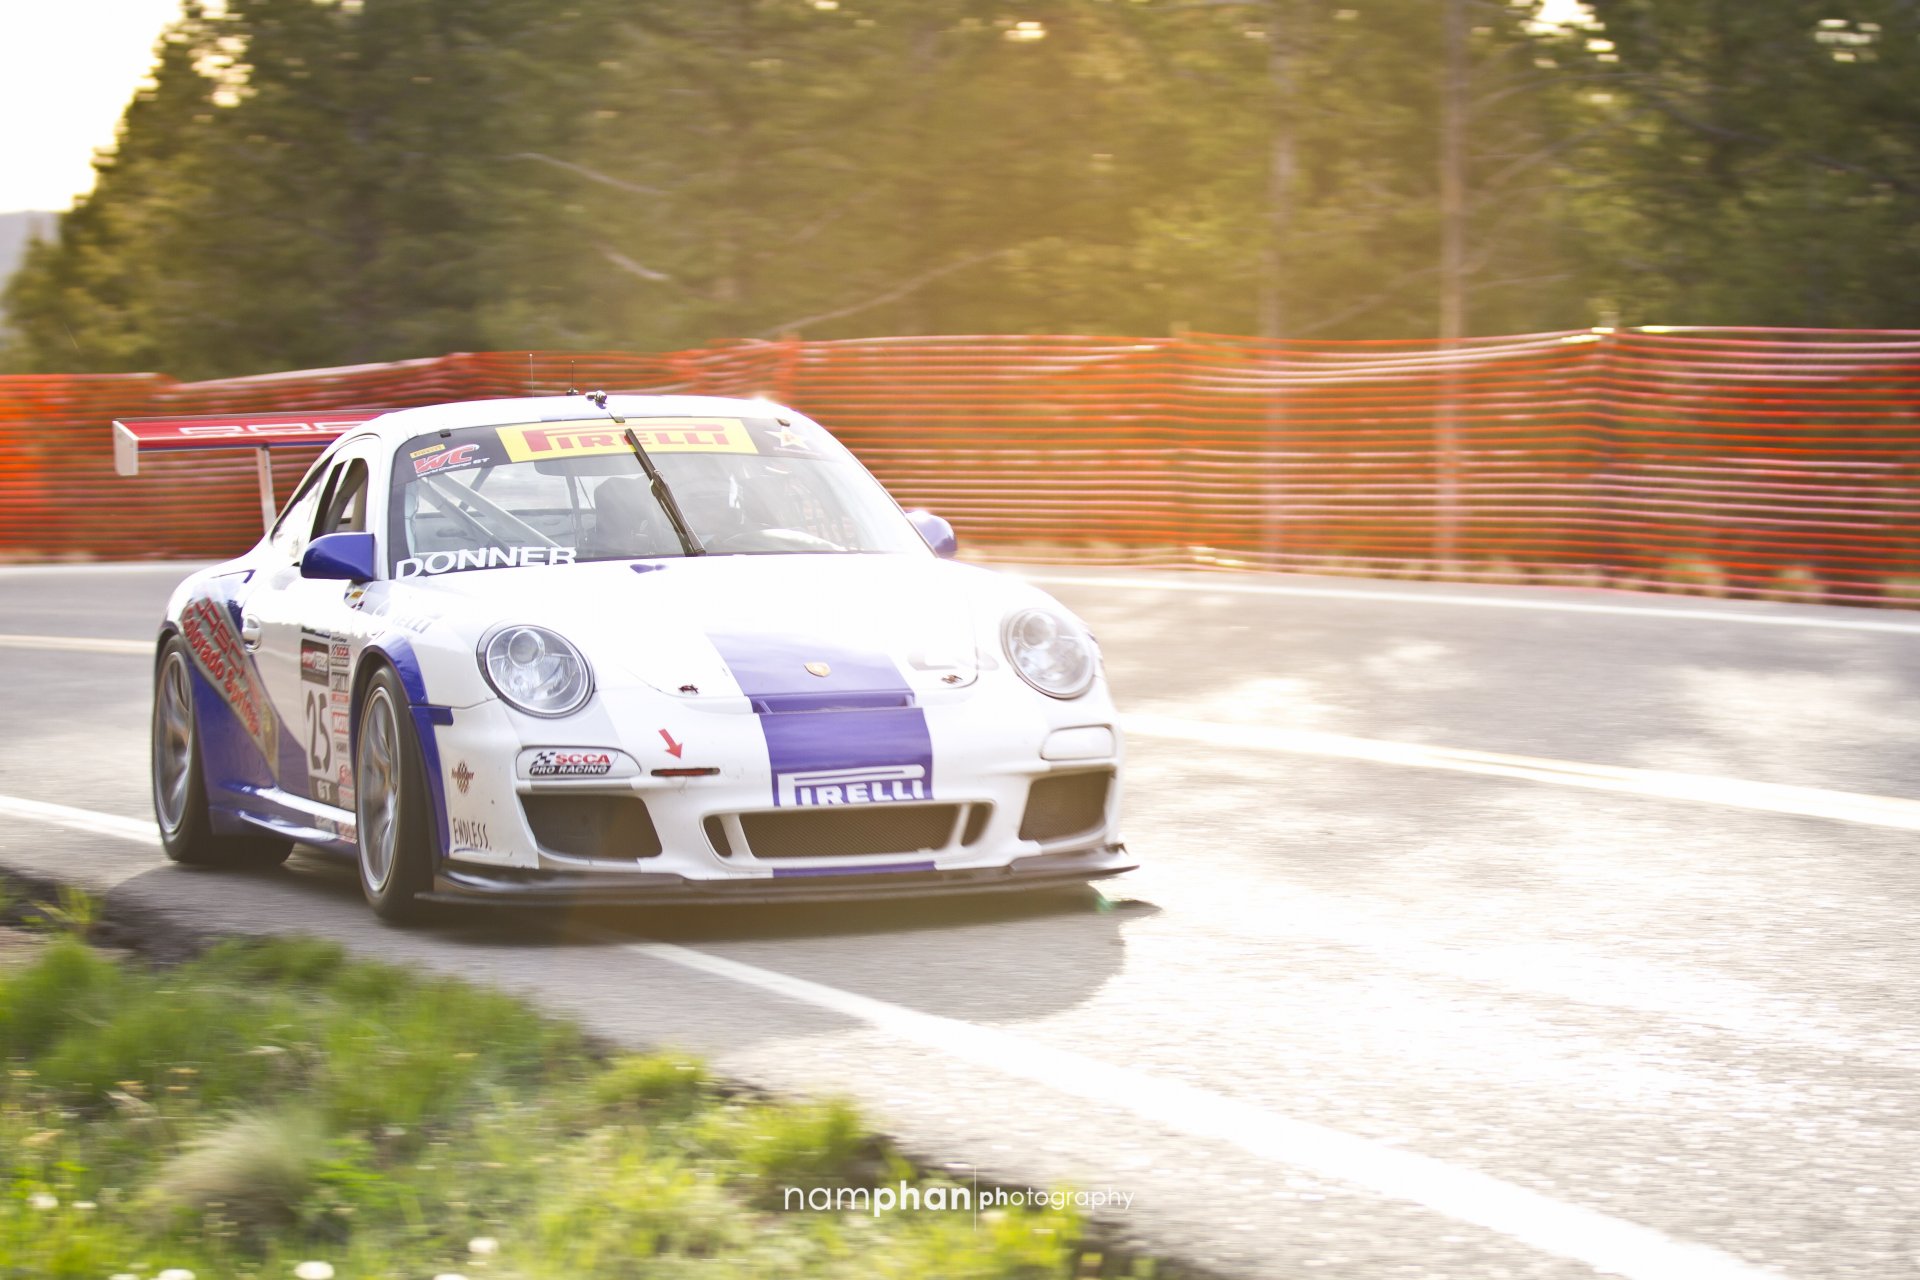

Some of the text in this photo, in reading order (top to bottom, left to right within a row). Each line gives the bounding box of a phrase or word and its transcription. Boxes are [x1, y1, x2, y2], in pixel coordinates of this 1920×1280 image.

[520, 424, 731, 453] PIRELLI
[413, 444, 480, 474] WC
[395, 546, 578, 581] DONNER
[305, 689, 332, 775] 25
[530, 764, 609, 775] PRO RACING
[555, 753, 612, 765] SCCA
[776, 763, 926, 808] PIRELLI
